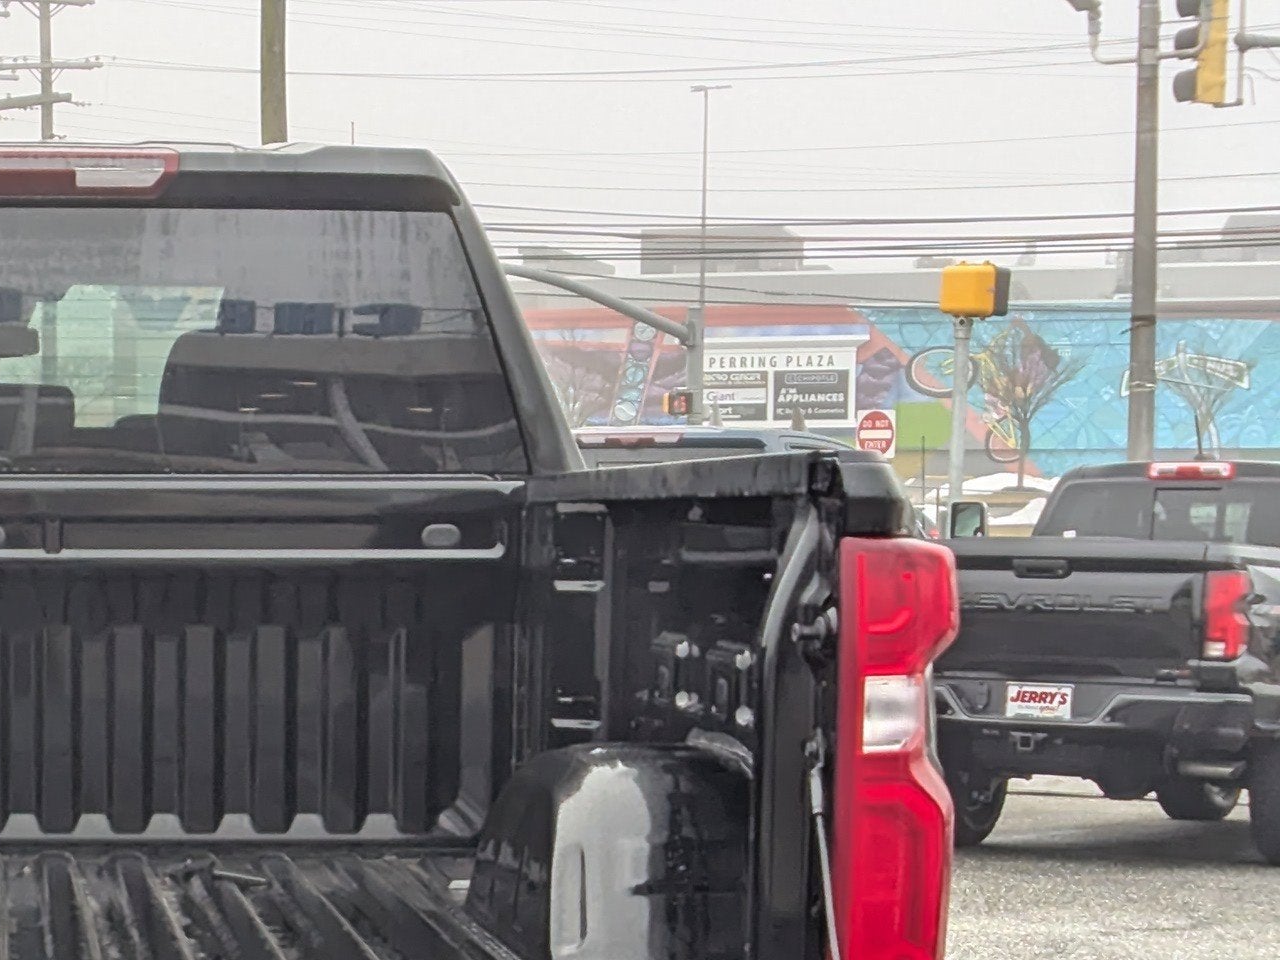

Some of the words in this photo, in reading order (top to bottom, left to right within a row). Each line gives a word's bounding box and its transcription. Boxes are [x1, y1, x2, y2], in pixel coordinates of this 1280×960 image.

[709, 356, 777, 368] PERRING
[786, 355, 835, 367] PLAZA
[777, 393, 844, 403] APPLIANCES
[875, 419, 889, 428] NOT
[1010, 690, 1068, 705] JERRY'S
